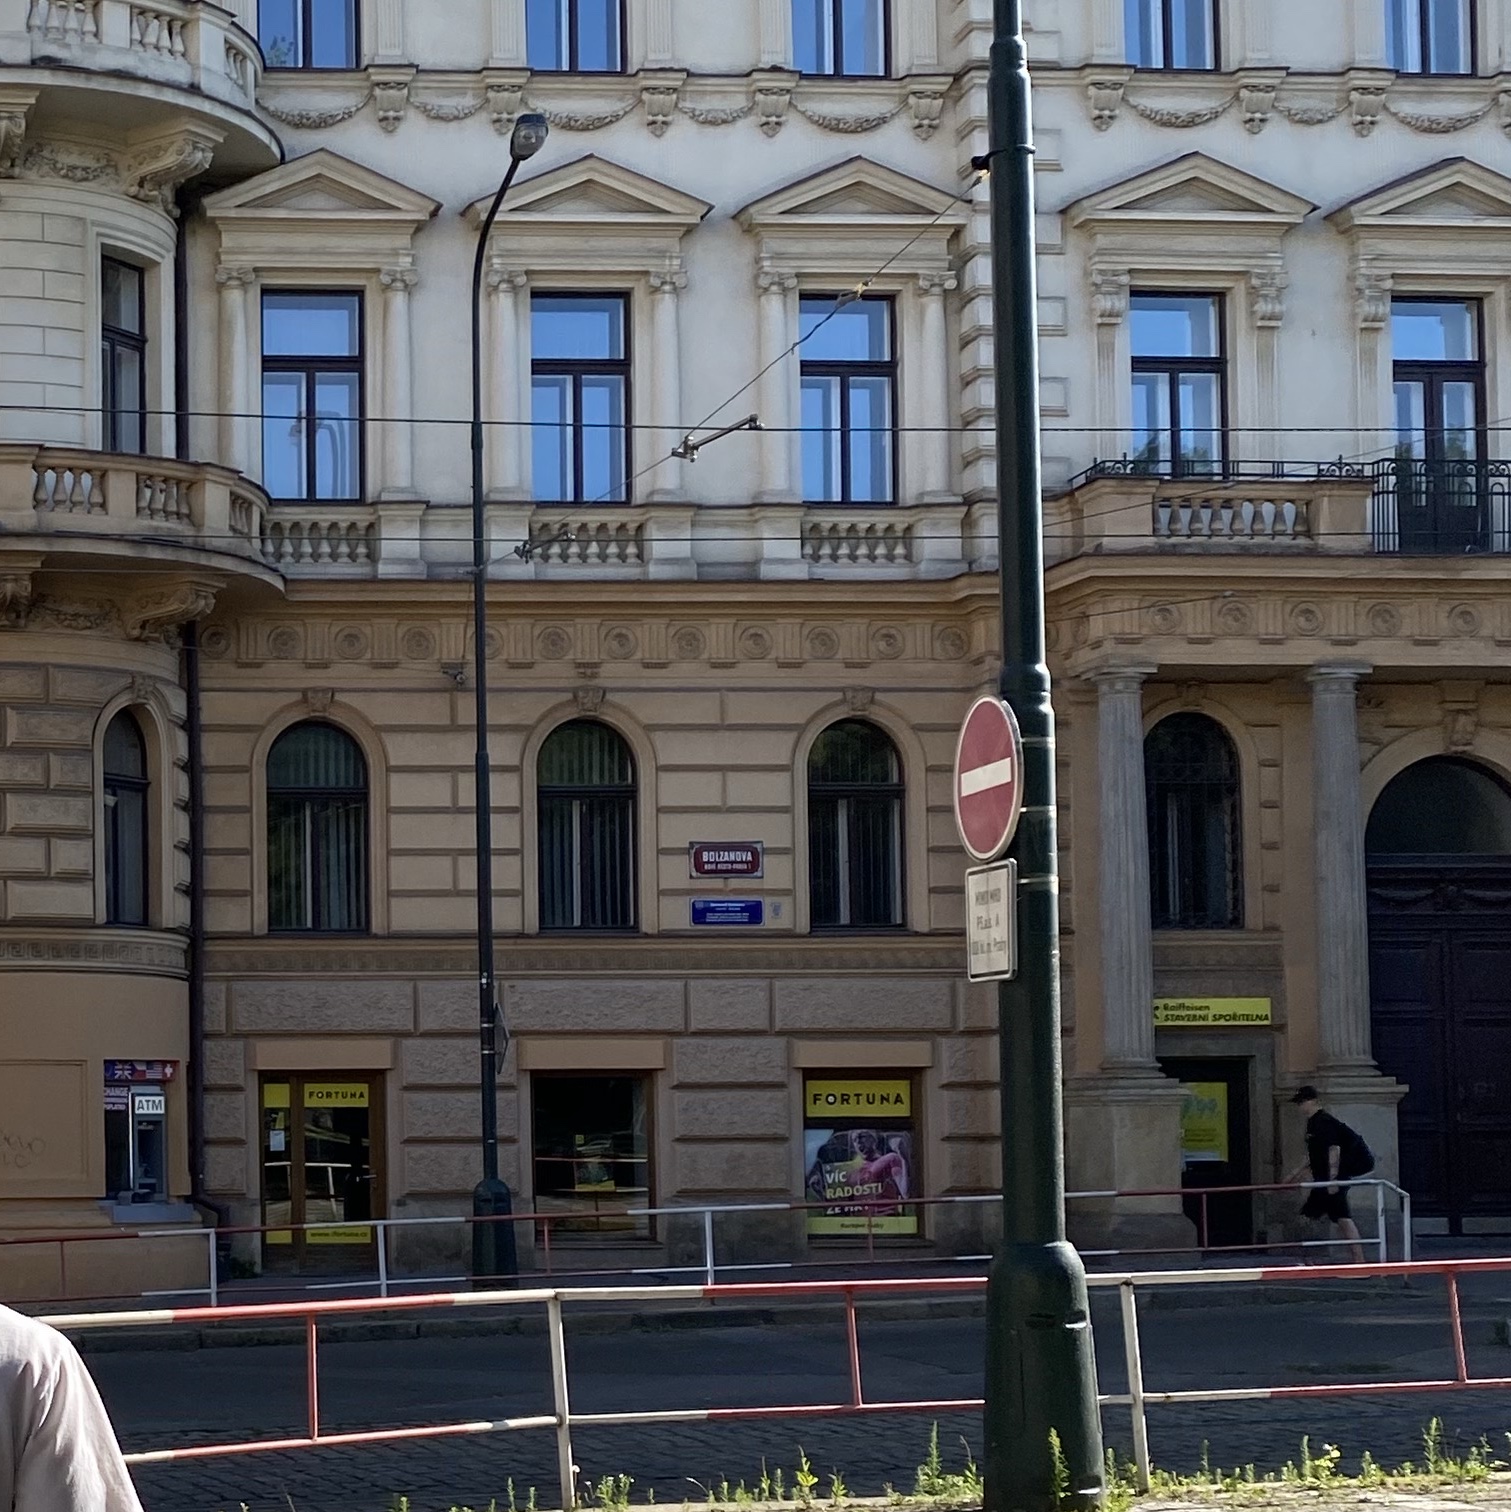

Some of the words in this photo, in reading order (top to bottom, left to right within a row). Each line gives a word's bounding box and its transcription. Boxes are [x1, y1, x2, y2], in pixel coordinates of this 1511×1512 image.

[702, 851, 753, 862] BOLZANOVA
[1163, 1003, 1210, 1011] Raiffeisen
[1211, 1012, 1270, 1022] SPOŘITELNA
[308, 1090, 365, 1100] FORTUNA
[813, 1093, 905, 1106] FORTUNA
[136, 1099, 163, 1112] ATM
[825, 1169, 847, 1184] VÍC
[826, 1183, 883, 1199] RADOSTI
